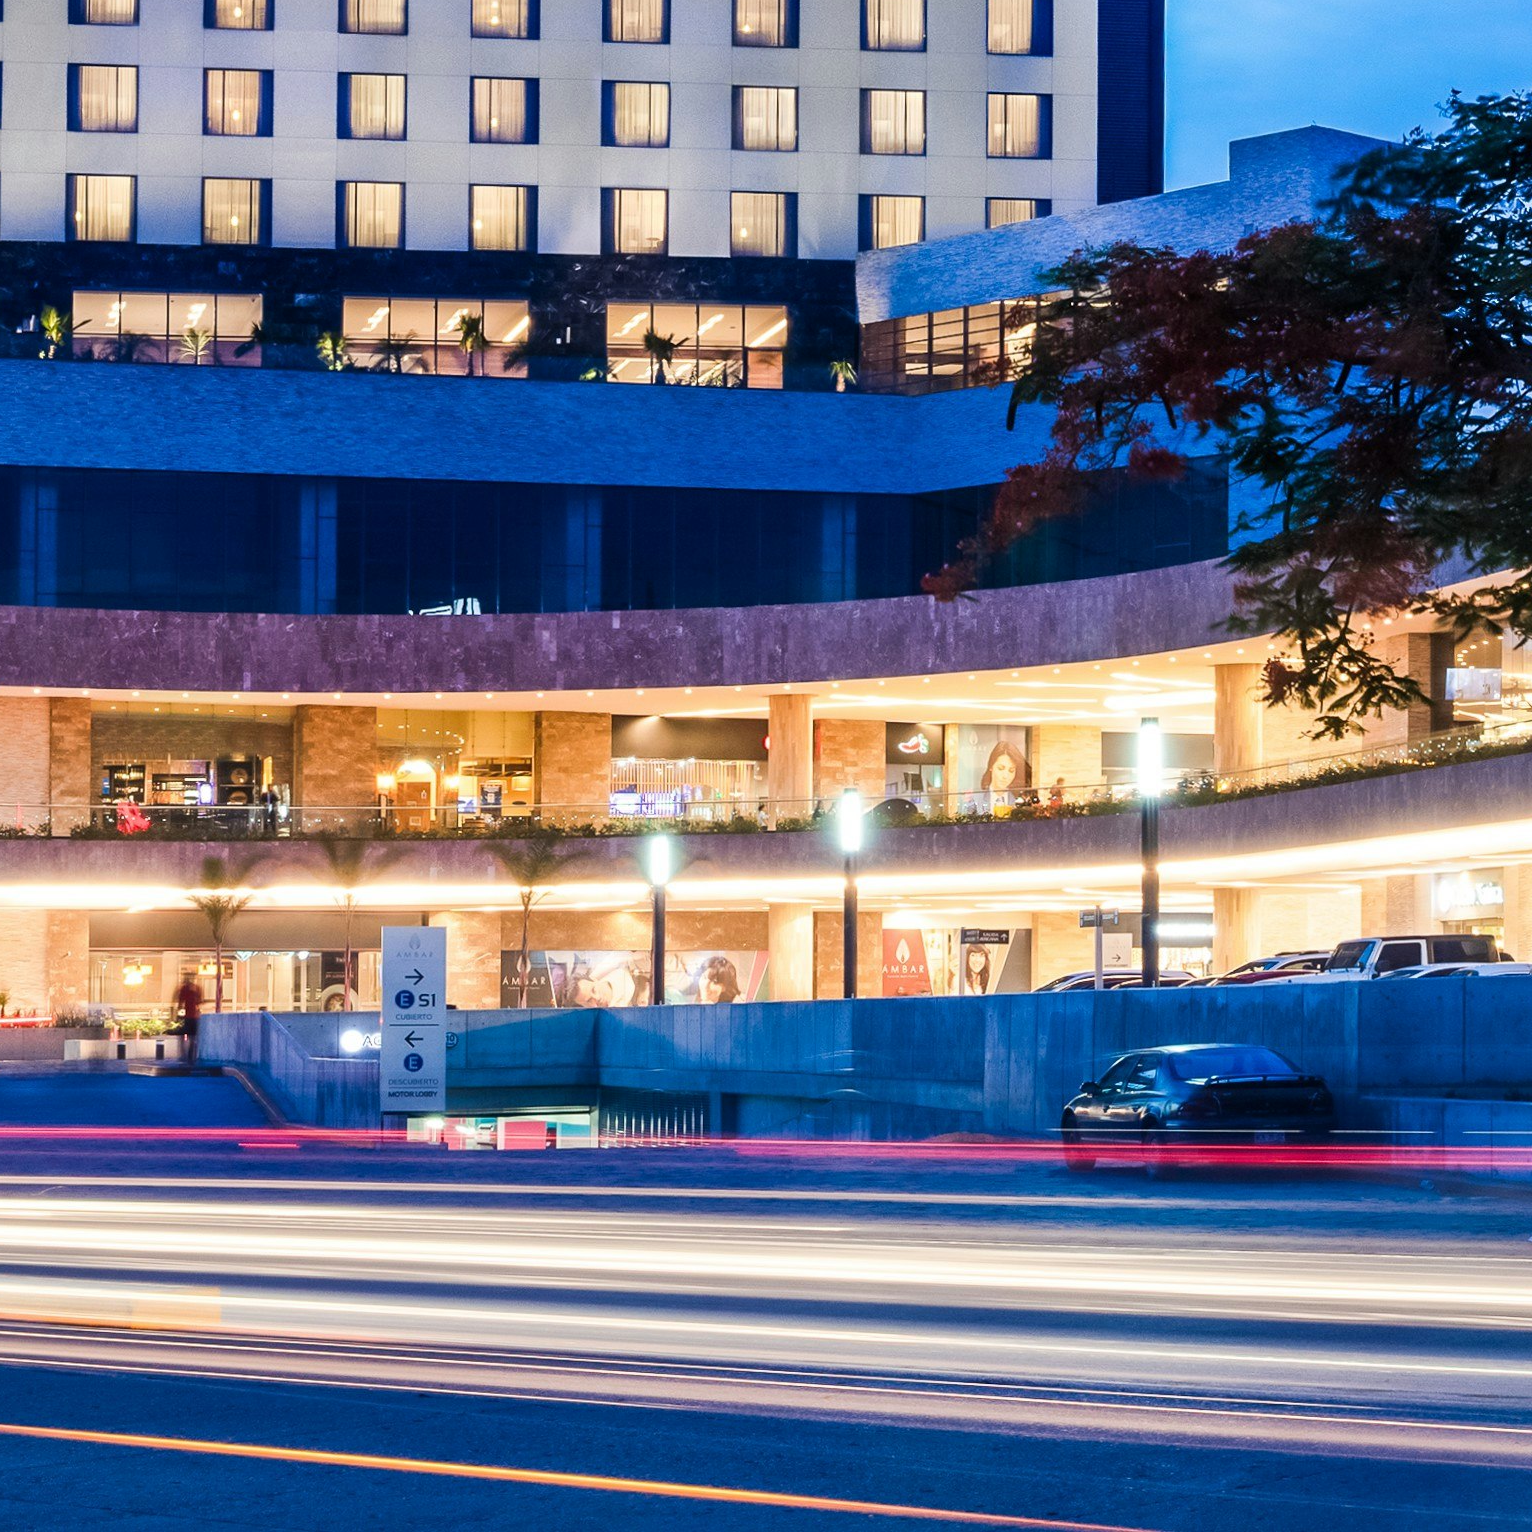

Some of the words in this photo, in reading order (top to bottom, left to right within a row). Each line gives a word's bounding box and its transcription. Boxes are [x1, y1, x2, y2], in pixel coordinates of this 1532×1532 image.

[418, 993, 436, 1007] S1
[395, 1013, 433, 1021] CUBIERTO
[388, 1078, 439, 1086] DESCUBIERTO
[388, 1090, 414, 1098] MOTOR
[415, 1090, 438, 1098] LOBBY
